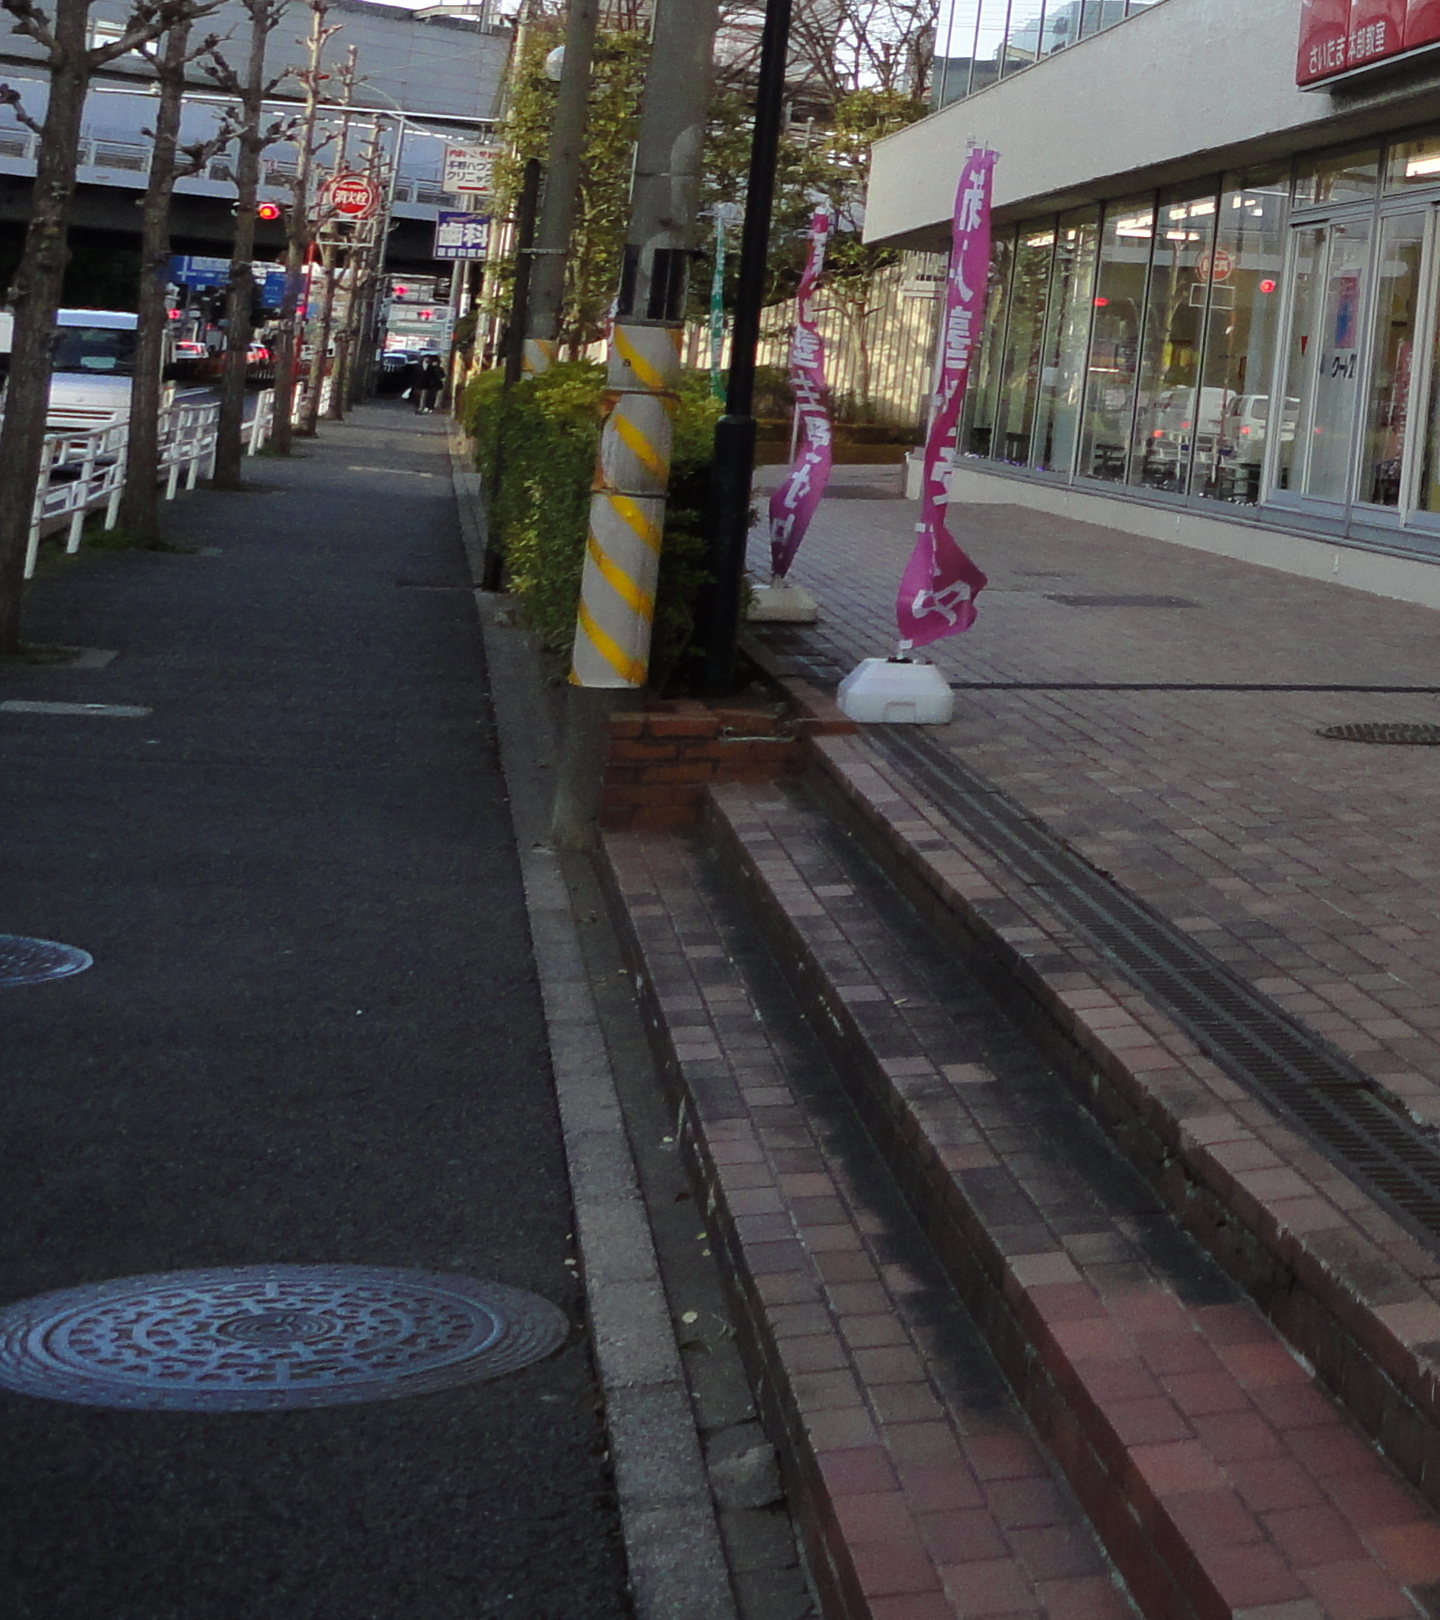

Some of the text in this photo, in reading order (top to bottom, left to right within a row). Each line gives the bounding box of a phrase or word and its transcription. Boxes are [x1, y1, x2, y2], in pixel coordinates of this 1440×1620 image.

[1309, 21, 1386, 74] さいたま本部教室
[334, 189, 369, 206] 消火栓
[438, 222, 488, 248] 歯科
